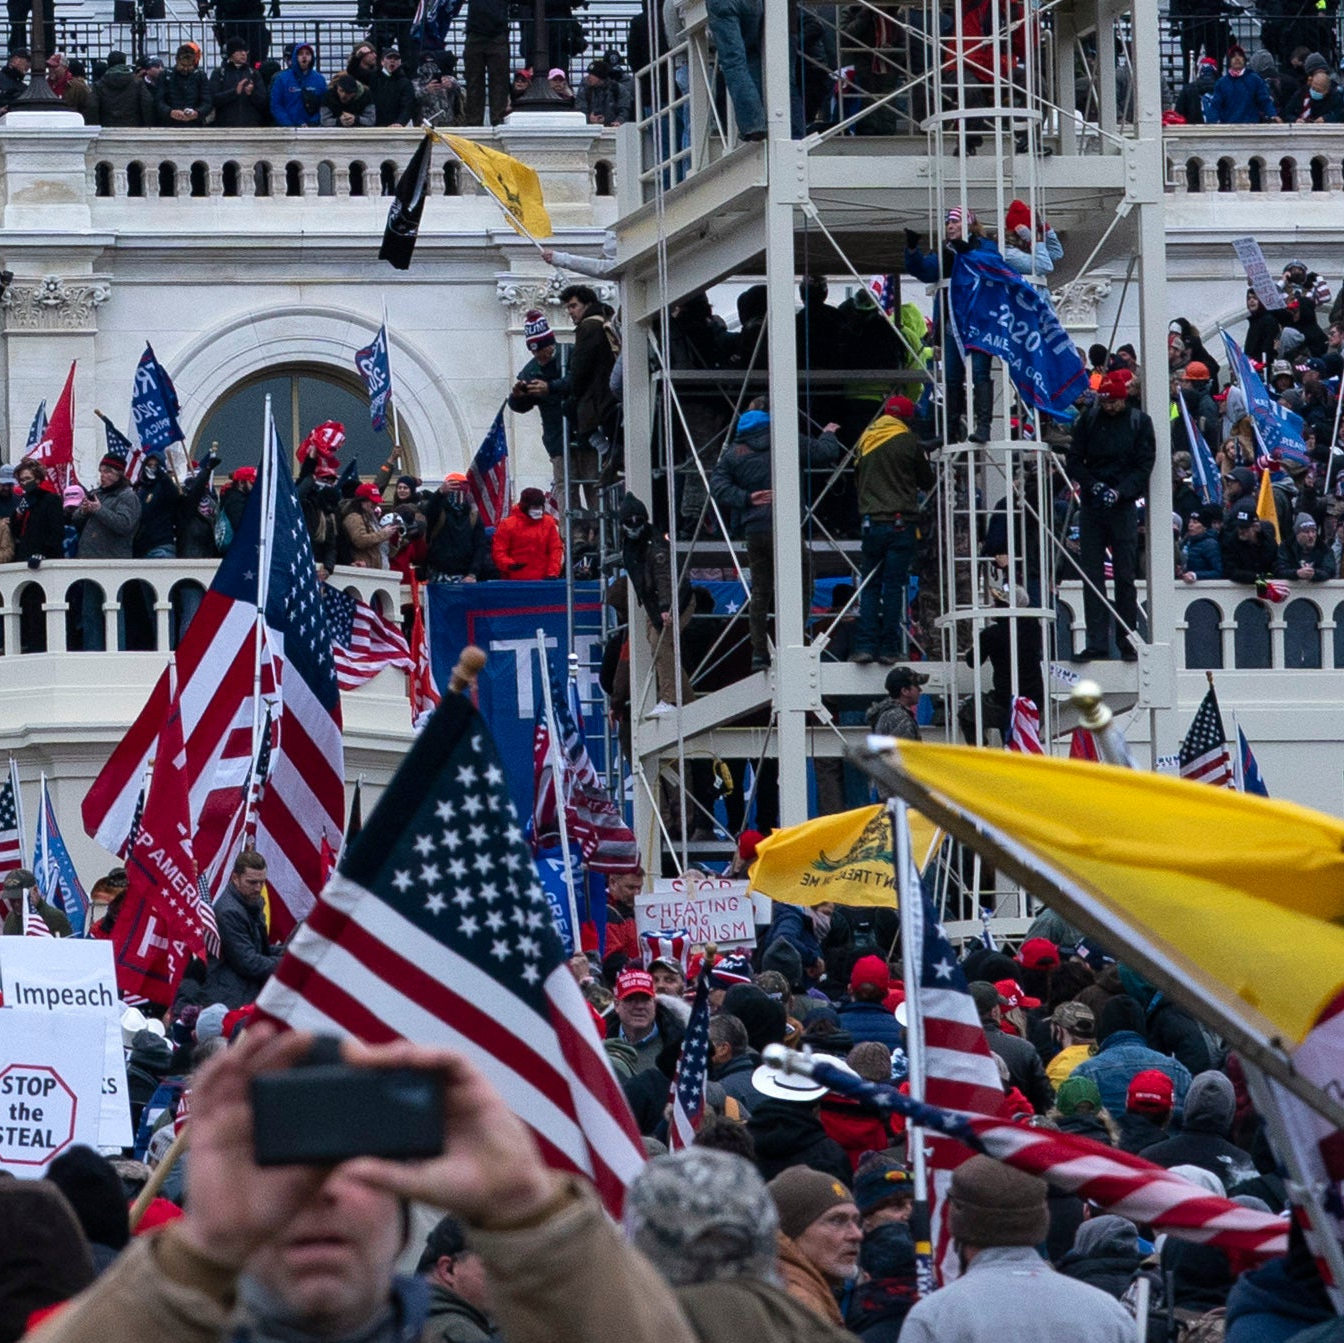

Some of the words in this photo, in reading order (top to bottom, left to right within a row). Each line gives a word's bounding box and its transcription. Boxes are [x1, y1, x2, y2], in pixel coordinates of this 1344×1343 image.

[147, 846, 202, 909] AMERI
[646, 896, 739, 919] CHEATING
[660, 913, 710, 929] LYING
[689, 922, 747, 943] UNISM
[15, 981, 114, 1011] Impeach
[1, 1075, 58, 1098] STOP
[9, 1102, 45, 1123] the
